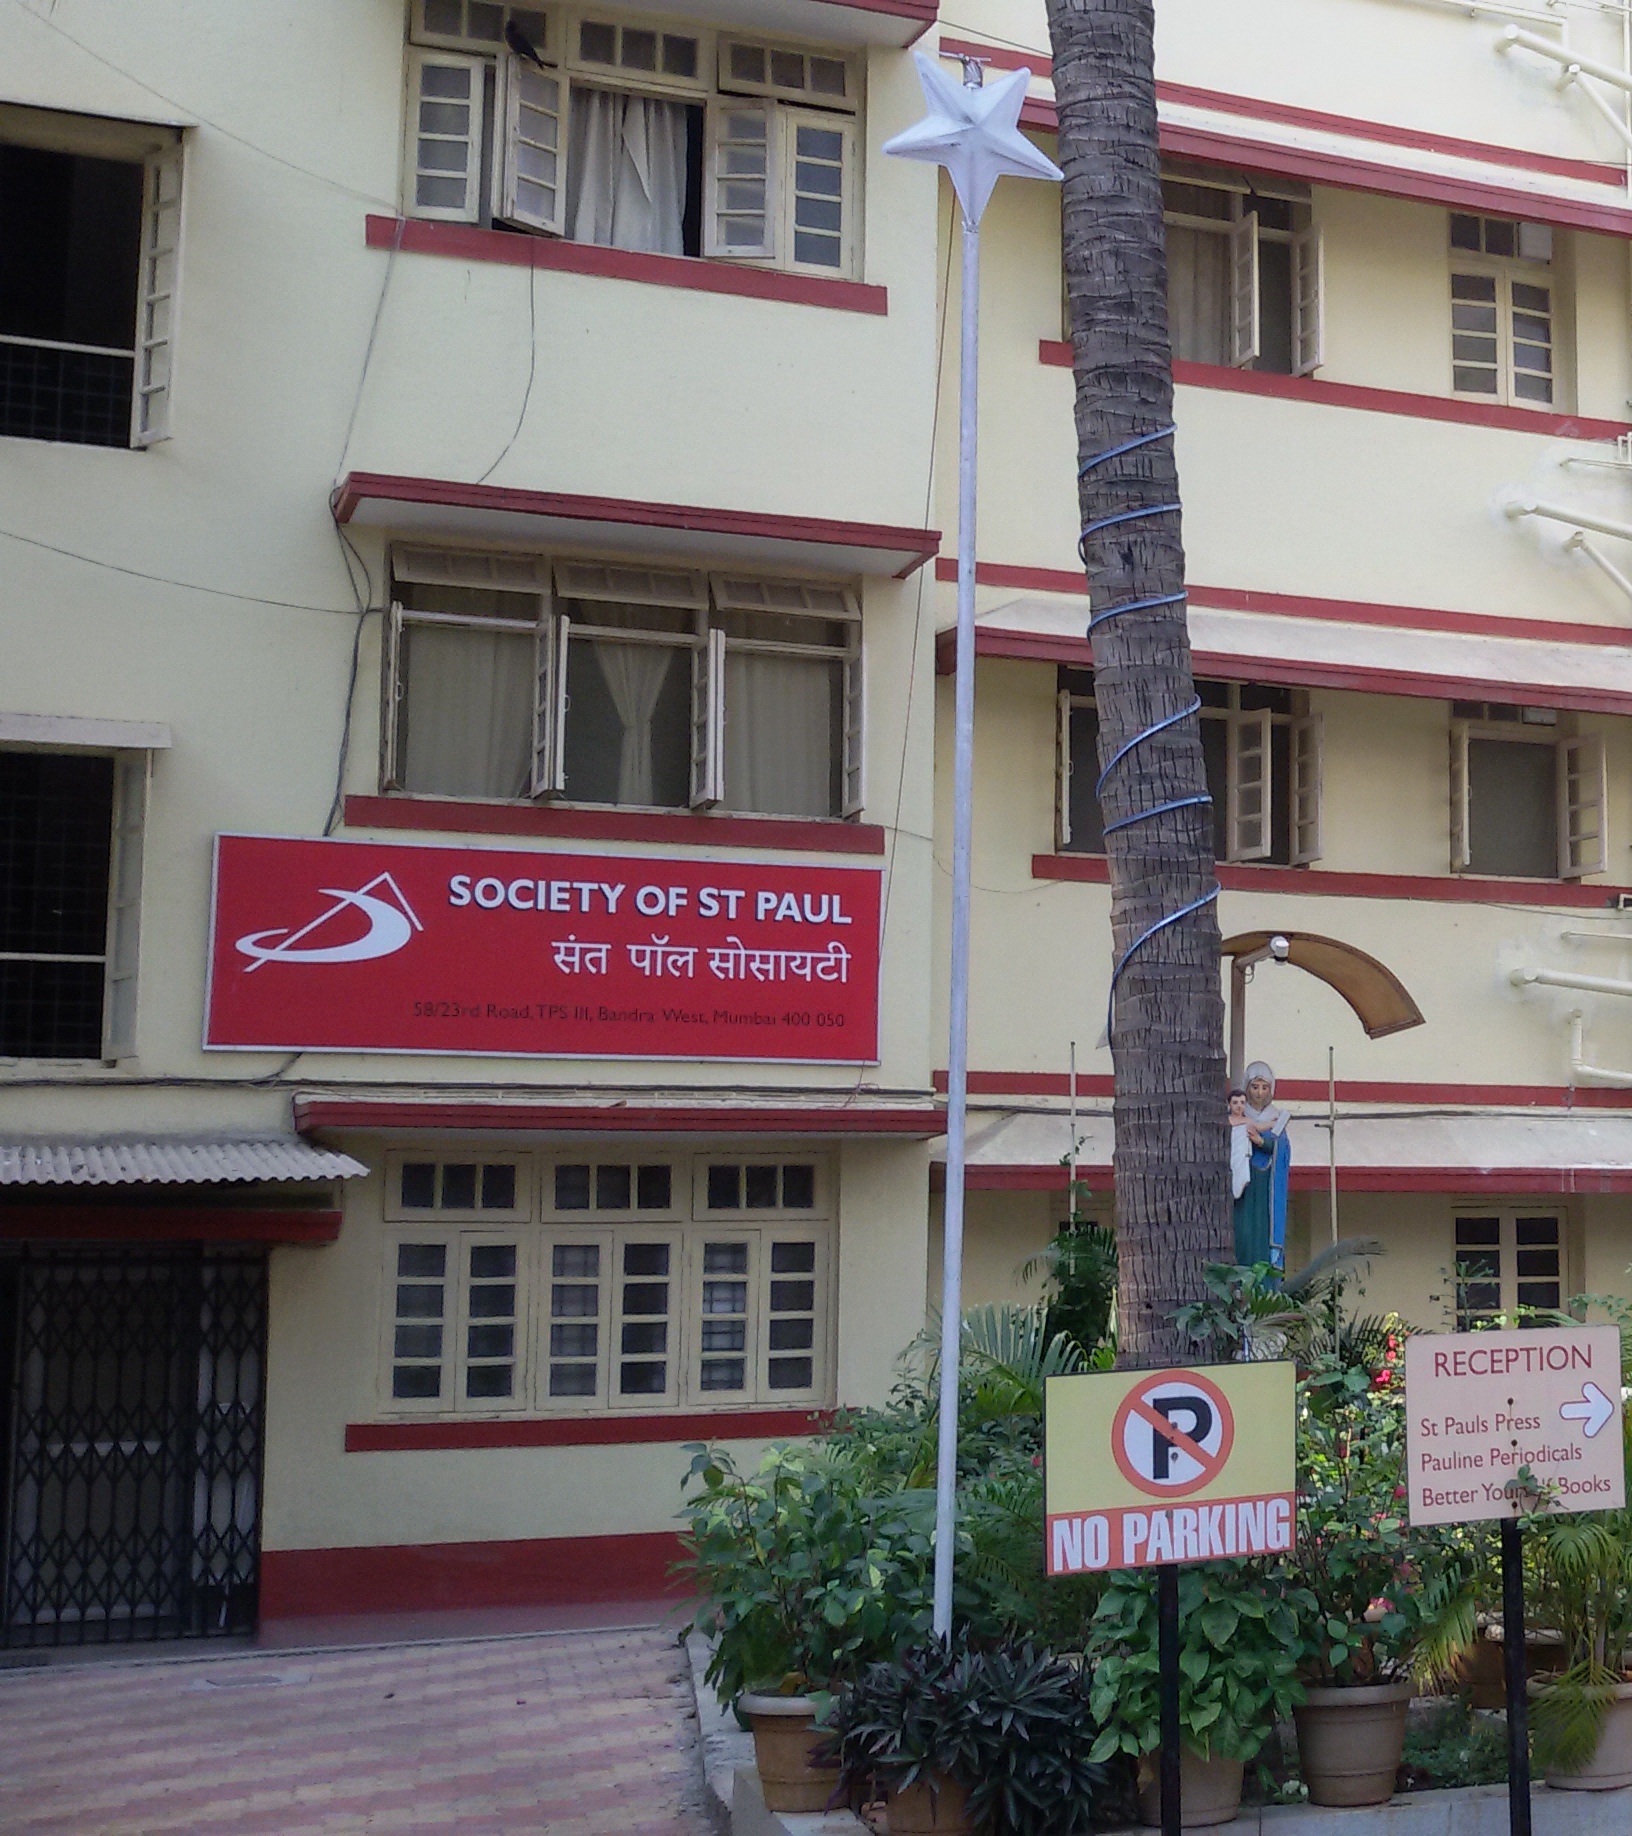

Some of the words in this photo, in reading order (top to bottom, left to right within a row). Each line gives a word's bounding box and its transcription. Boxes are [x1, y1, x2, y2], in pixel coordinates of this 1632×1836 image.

[449, 875, 626, 914] SOCIETY
[635, 885, 688, 917] OF
[698, 888, 745, 919] ST
[756, 891, 852, 924] PAUL
[551, 933, 611, 975] संत
[627, 932, 698, 978] पॉल
[707, 936, 851, 983] सोसायटी
[413, 1002, 480, 1018] 58/23rd
[536, 1004, 567, 1019] TPS
[599, 1006, 654, 1022] Bandra
[713, 1010, 776, 1025] Mumbai
[782, 1011, 810, 1026] 400
[817, 1012, 844, 1027] 050
[1434, 1345, 1593, 1378] RECEPTION
[1153, 1396, 1213, 1480] P
[1420, 1417, 1438, 1437] St
[1445, 1415, 1489, 1435] Pauls
[1495, 1413, 1541, 1432] Press
[1421, 1451, 1483, 1472] Pauline
[1490, 1442, 1582, 1466] Periodicals
[1422, 1488, 1478, 1507] Better
[1558, 1474, 1611, 1495] Books
[1052, 1515, 1110, 1572] NO
[1122, 1498, 1291, 1565] PARKING
